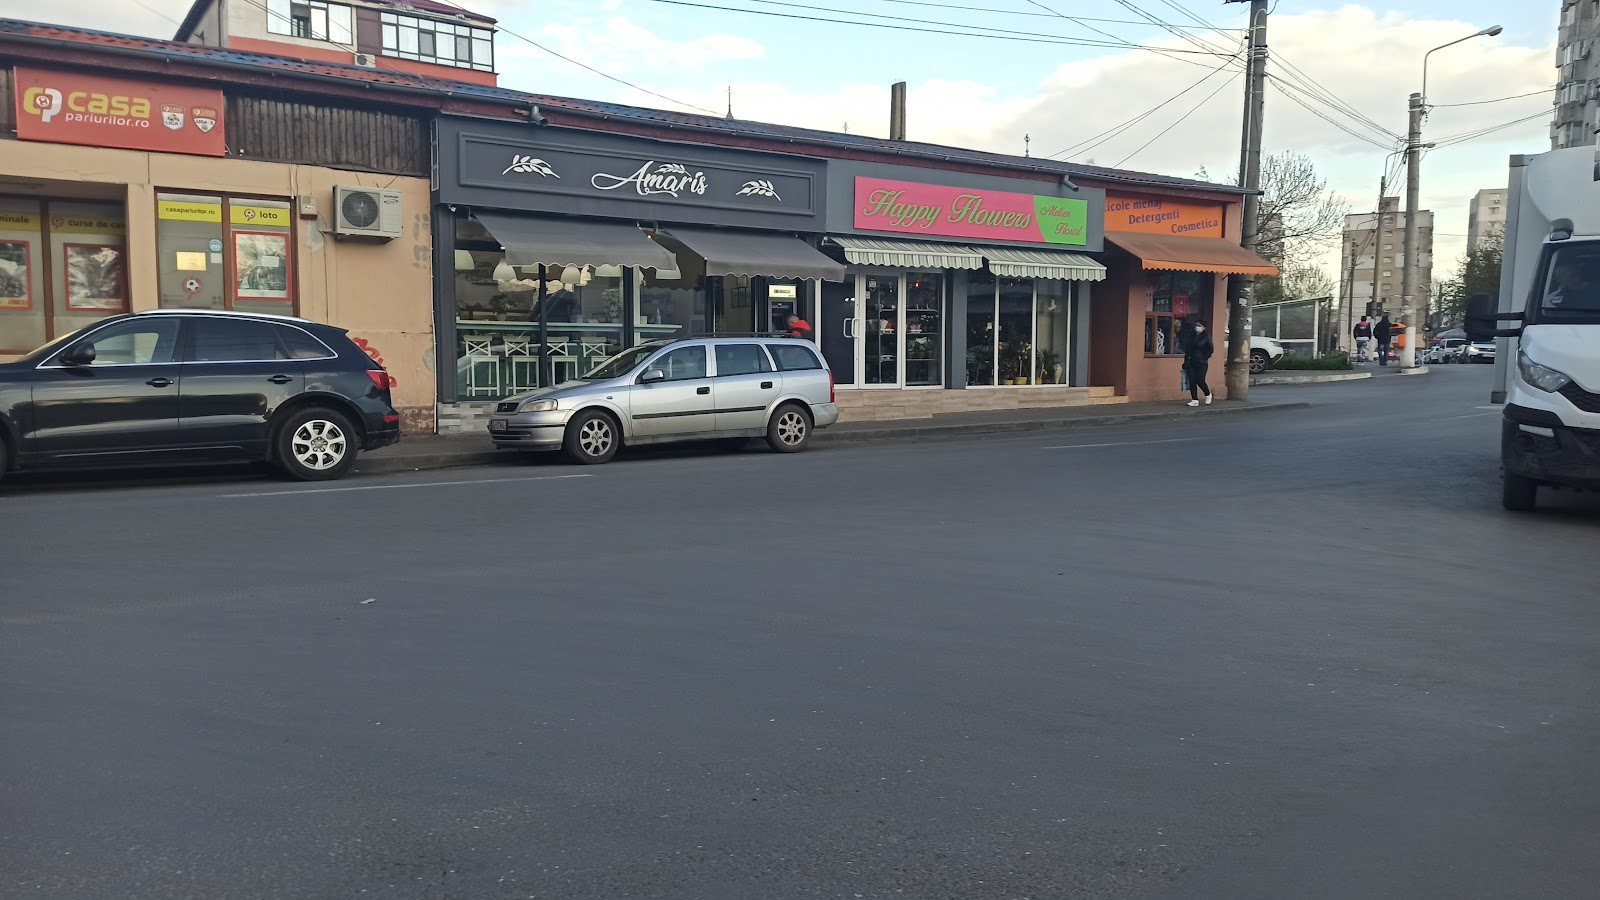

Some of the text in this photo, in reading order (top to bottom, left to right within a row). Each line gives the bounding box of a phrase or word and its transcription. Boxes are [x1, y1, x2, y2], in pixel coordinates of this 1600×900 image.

[67, 91, 150, 118] casa
[65, 112, 150, 128] pariurilor.ro
[591, 161, 708, 198] Amaris
[259, 211, 278, 219] loto
[862, 189, 1032, 228] Happy Flowers
[68, 220, 94, 228] curse
[96, 219, 108, 228] de
[1128, 209, 1180, 224] Detergenti
[1171, 219, 1219, 234] Cosmetica
